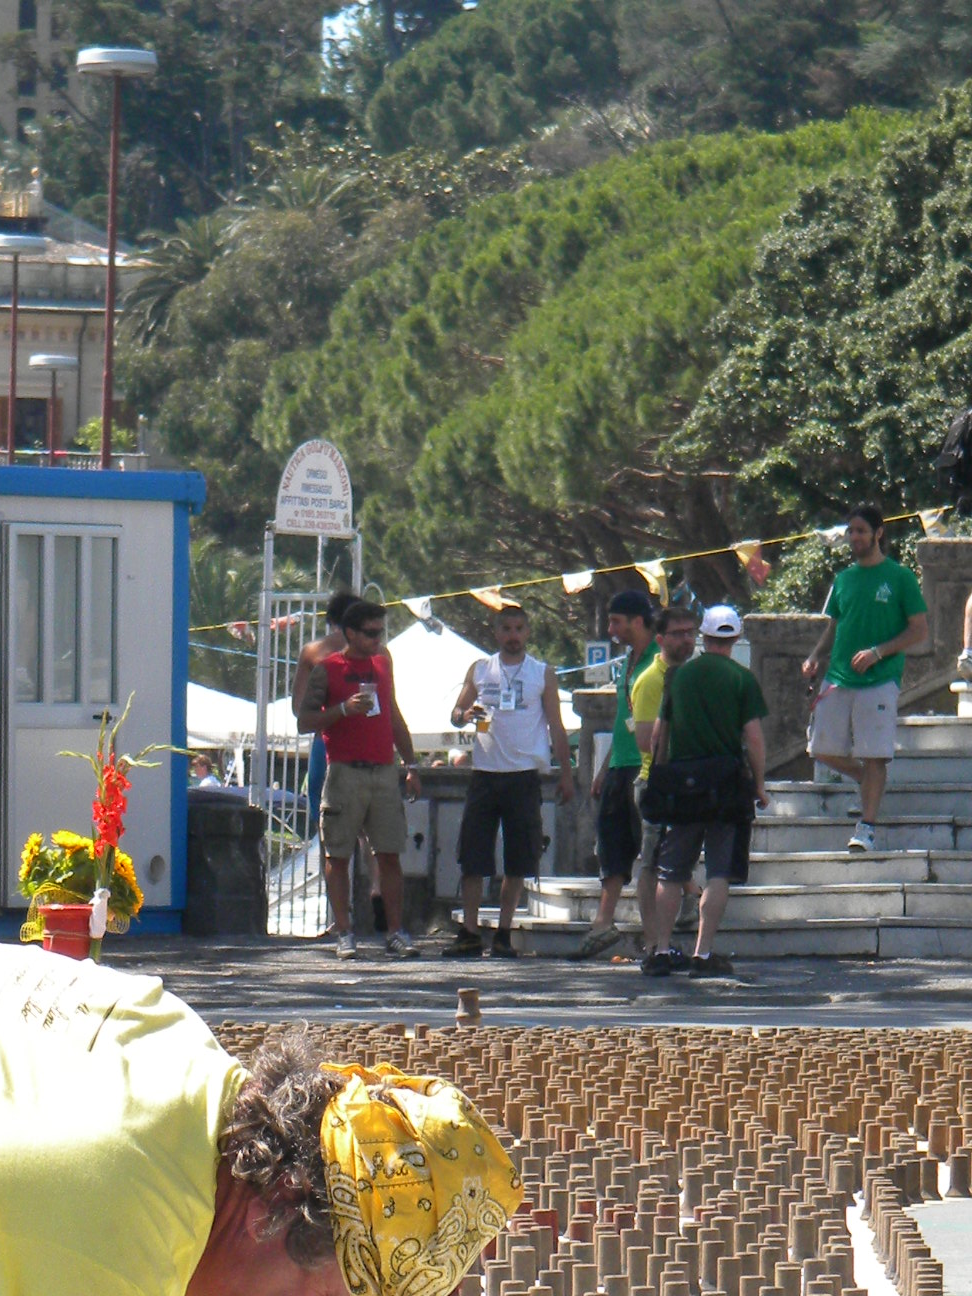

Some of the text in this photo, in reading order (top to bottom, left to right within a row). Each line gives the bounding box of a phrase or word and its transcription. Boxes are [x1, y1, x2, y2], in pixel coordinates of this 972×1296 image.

[280, 496, 348, 510] AFFITTASI POSTI BARCA
[592, 649, 603, 665] P
